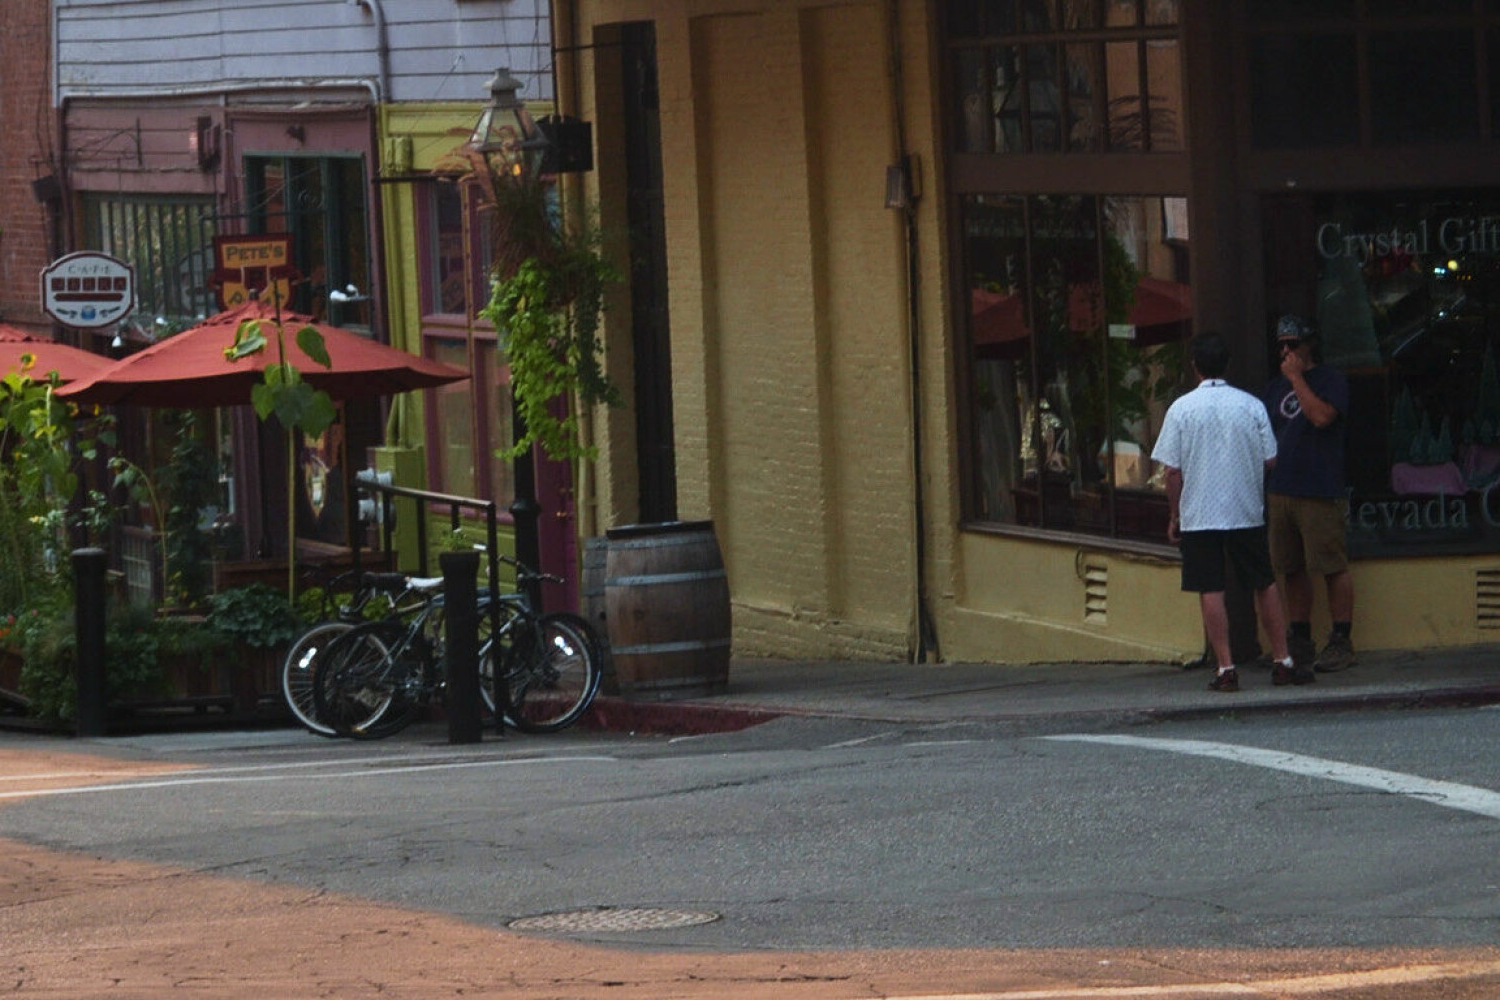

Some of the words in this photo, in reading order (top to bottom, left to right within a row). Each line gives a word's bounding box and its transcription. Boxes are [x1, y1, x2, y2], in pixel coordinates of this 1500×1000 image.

[226, 244, 284, 261] PETE'S
[1318, 218, 1428, 268] Crystal
[1439, 215, 1500, 254] Gift
